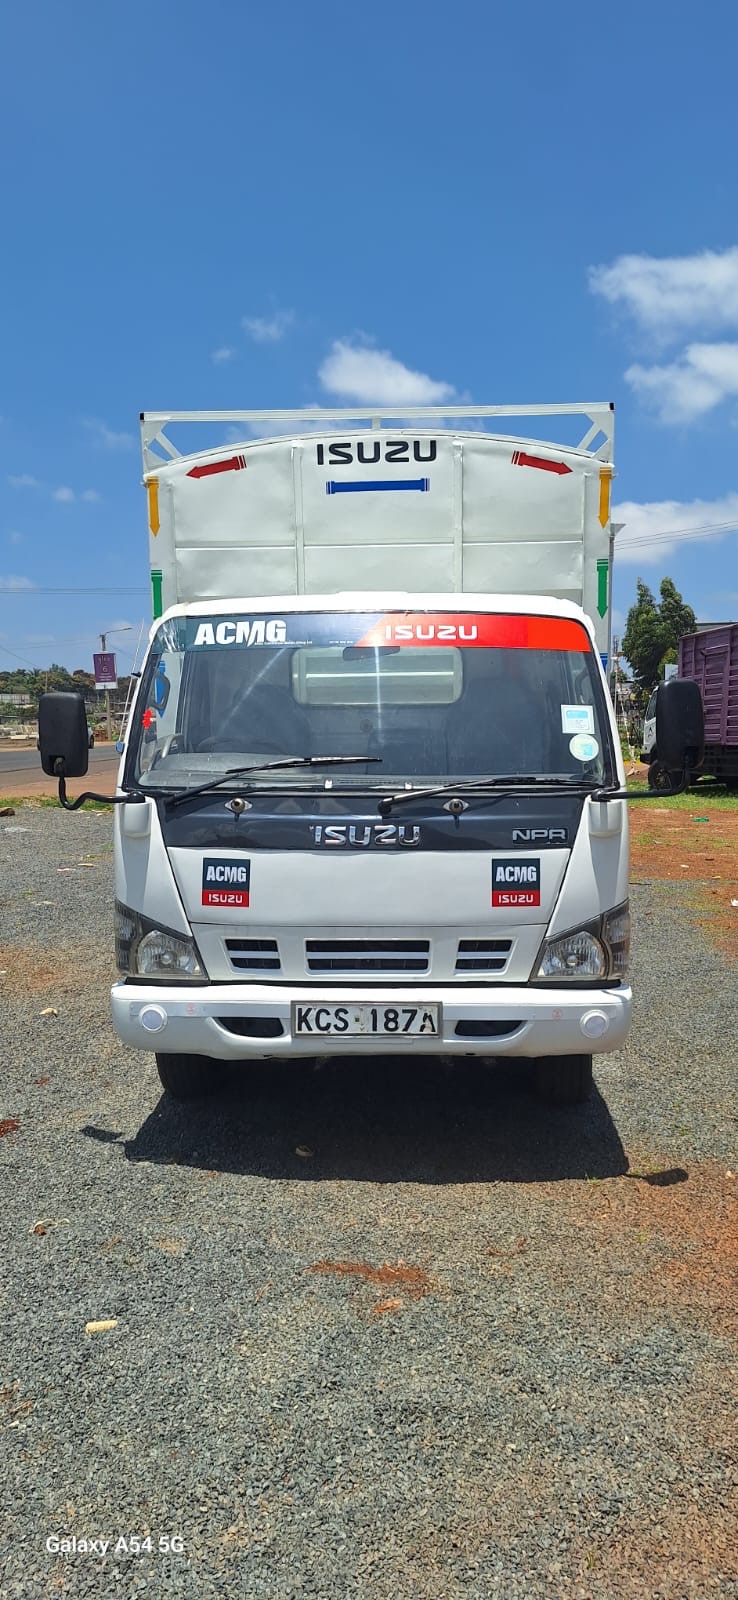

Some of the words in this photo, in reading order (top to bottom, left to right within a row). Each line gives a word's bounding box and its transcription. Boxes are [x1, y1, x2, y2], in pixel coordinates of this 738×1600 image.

[316, 439, 437, 465] ISUZU
[193, 620, 287, 647] ACMG
[385, 625, 478, 640] ISUZU
[314, 824, 420, 846] ISUZU
[512, 829, 566, 841] NPR
[206, 865, 247, 884] ACMG
[495, 866, 537, 884] ACMG
[208, 893, 243, 904] ISUZU
[498, 894, 534, 904] ISUZU
[297, 1007, 349, 1032] KCS
[370, 1008, 436, 1033] 187A
